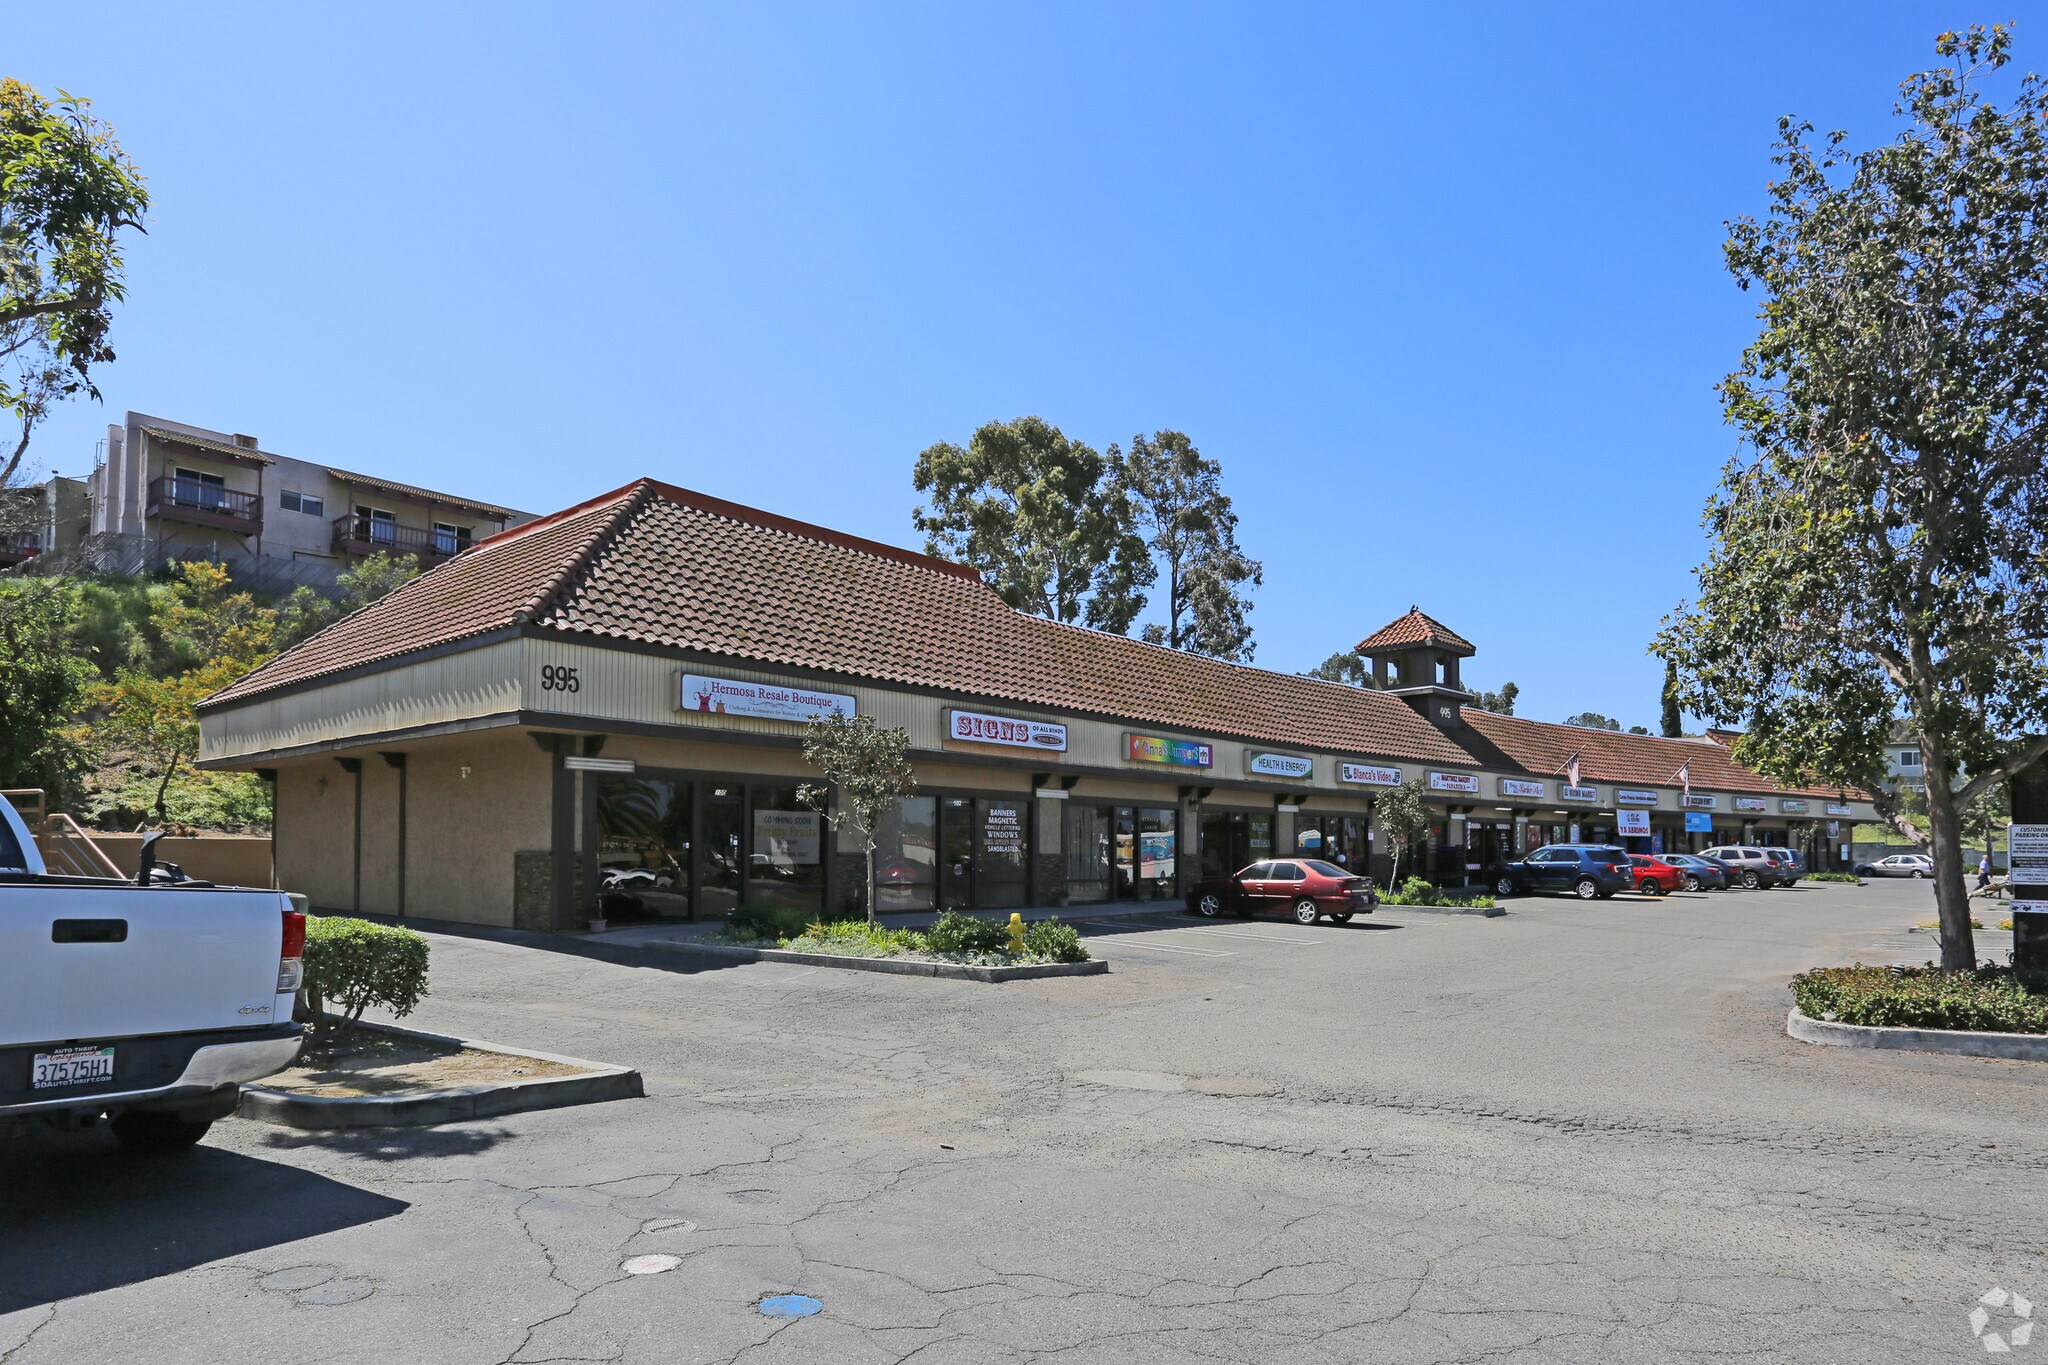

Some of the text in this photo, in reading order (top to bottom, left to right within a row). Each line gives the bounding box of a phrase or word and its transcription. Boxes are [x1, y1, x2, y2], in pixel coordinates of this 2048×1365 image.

[541, 664, 579, 693] 995
[711, 681, 832, 708] Hermosa Resale Boutique
[957, 715, 1029, 743] SIGNS
[1258, 757, 1307, 773] HEALTH & ENERGY
[1353, 767, 1392, 782] Blanca's Video
[990, 809, 1016, 817] BANNERS
[794, 816, 811, 825] SOON
[988, 817, 1017, 825] MAGNETIC
[987, 831, 1019, 839] WINDOWS
[987, 845, 1019, 853] SANDBLASTED
[238, 1003, 271, 1015] 4x4
[36, 1058, 110, 1082] 37575H1
